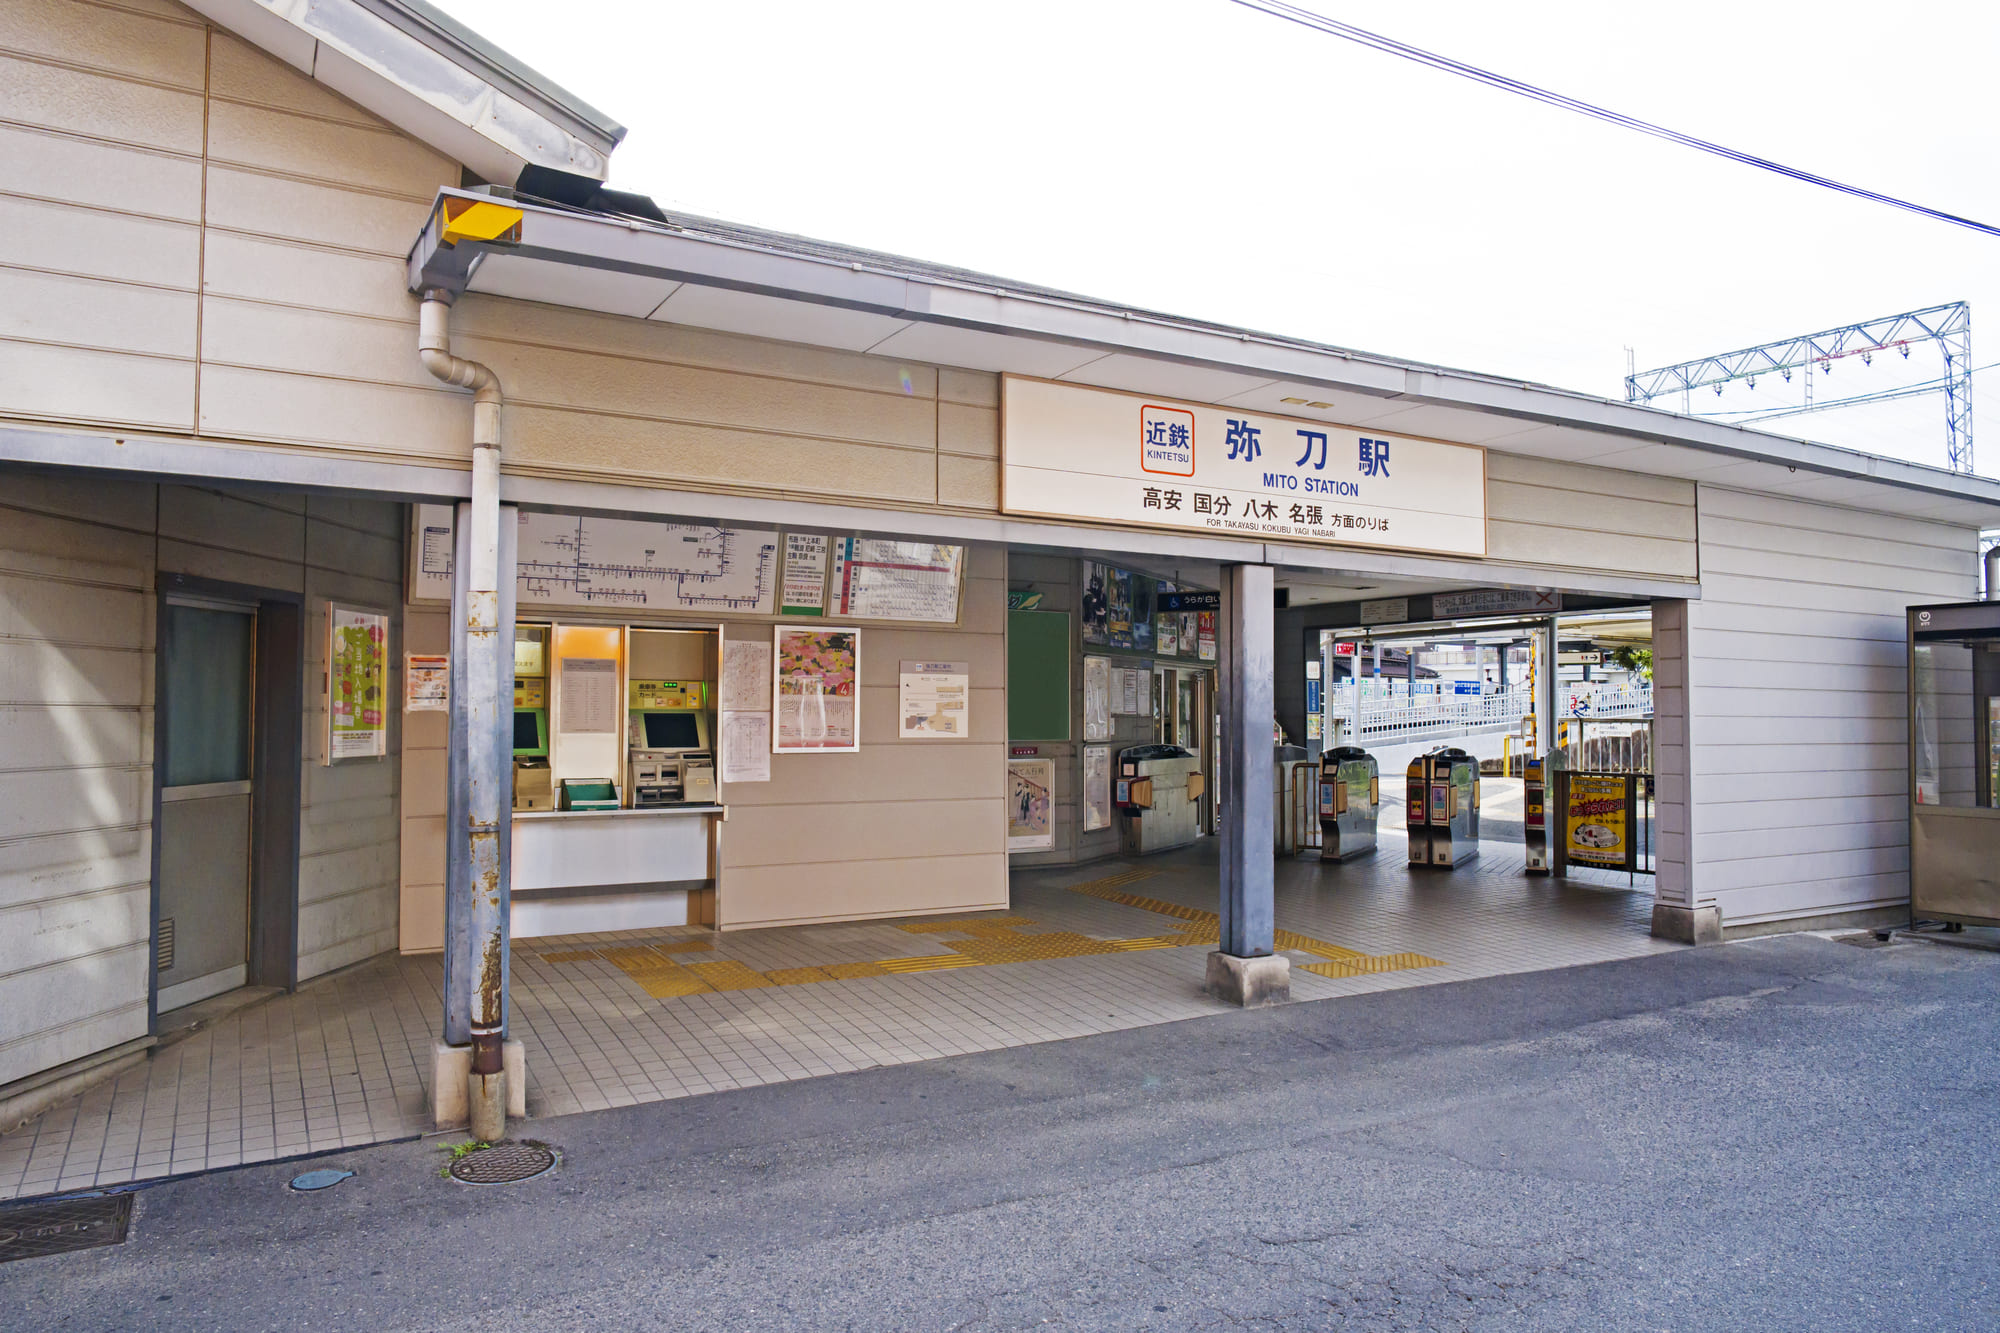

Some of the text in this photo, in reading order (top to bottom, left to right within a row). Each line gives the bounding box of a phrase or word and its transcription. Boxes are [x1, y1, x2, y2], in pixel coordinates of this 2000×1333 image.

[1146, 420, 1190, 449] 近鉄
[1147, 449, 1189, 463] KINTETSU
[1263, 472, 1359, 497] MITO STATION
[1143, 487, 1182, 511] 高安
[1193, 492, 1232, 516] 国分
[1243, 499, 1279, 521] 八木
[1288, 503, 1323, 526] 名張
[1206, 518, 1336, 538] FOR TAKAYASU KOKUBU YAGI NABARI
